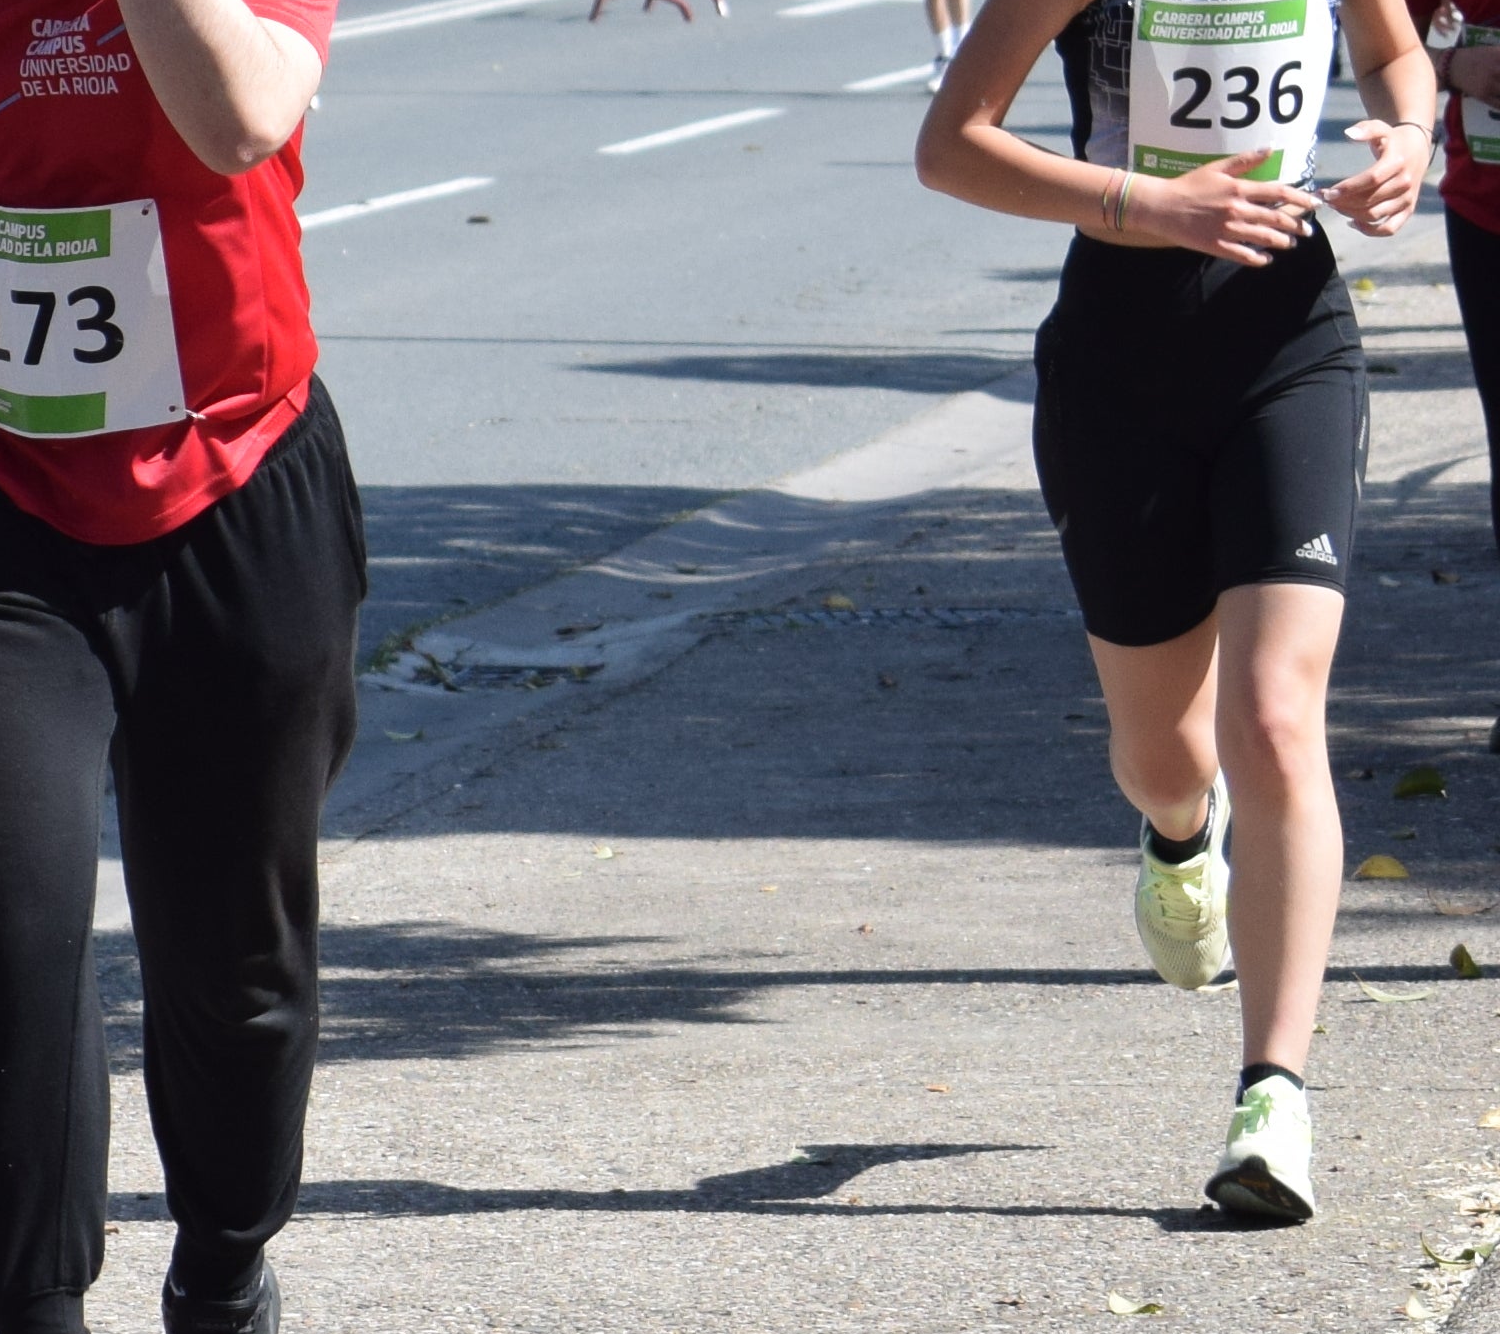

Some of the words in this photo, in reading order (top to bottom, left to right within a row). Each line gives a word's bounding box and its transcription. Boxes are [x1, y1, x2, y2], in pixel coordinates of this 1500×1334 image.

[1153, 10, 1212, 25] CARRERA
[1213, 10, 1265, 25] CAMPUS
[1149, 25, 1233, 41] UNIVERSIDAD
[1233, 25, 1251, 40] DE
[1252, 23, 1268, 38] LA
[1268, 20, 1299, 36] RIOJA
[20, 53, 131, 78] UNIVERSIDAD
[20, 80, 46, 97] DE
[46, 78, 71, 95] LA
[72, 75, 119, 95] RIOJA
[1170, 60, 1304, 129] 236
[15, 241, 31, 257] DE
[33, 241, 53, 257] LA
[55, 238, 98, 257] RIOJA
[1295, 548, 1338, 566] adidas
